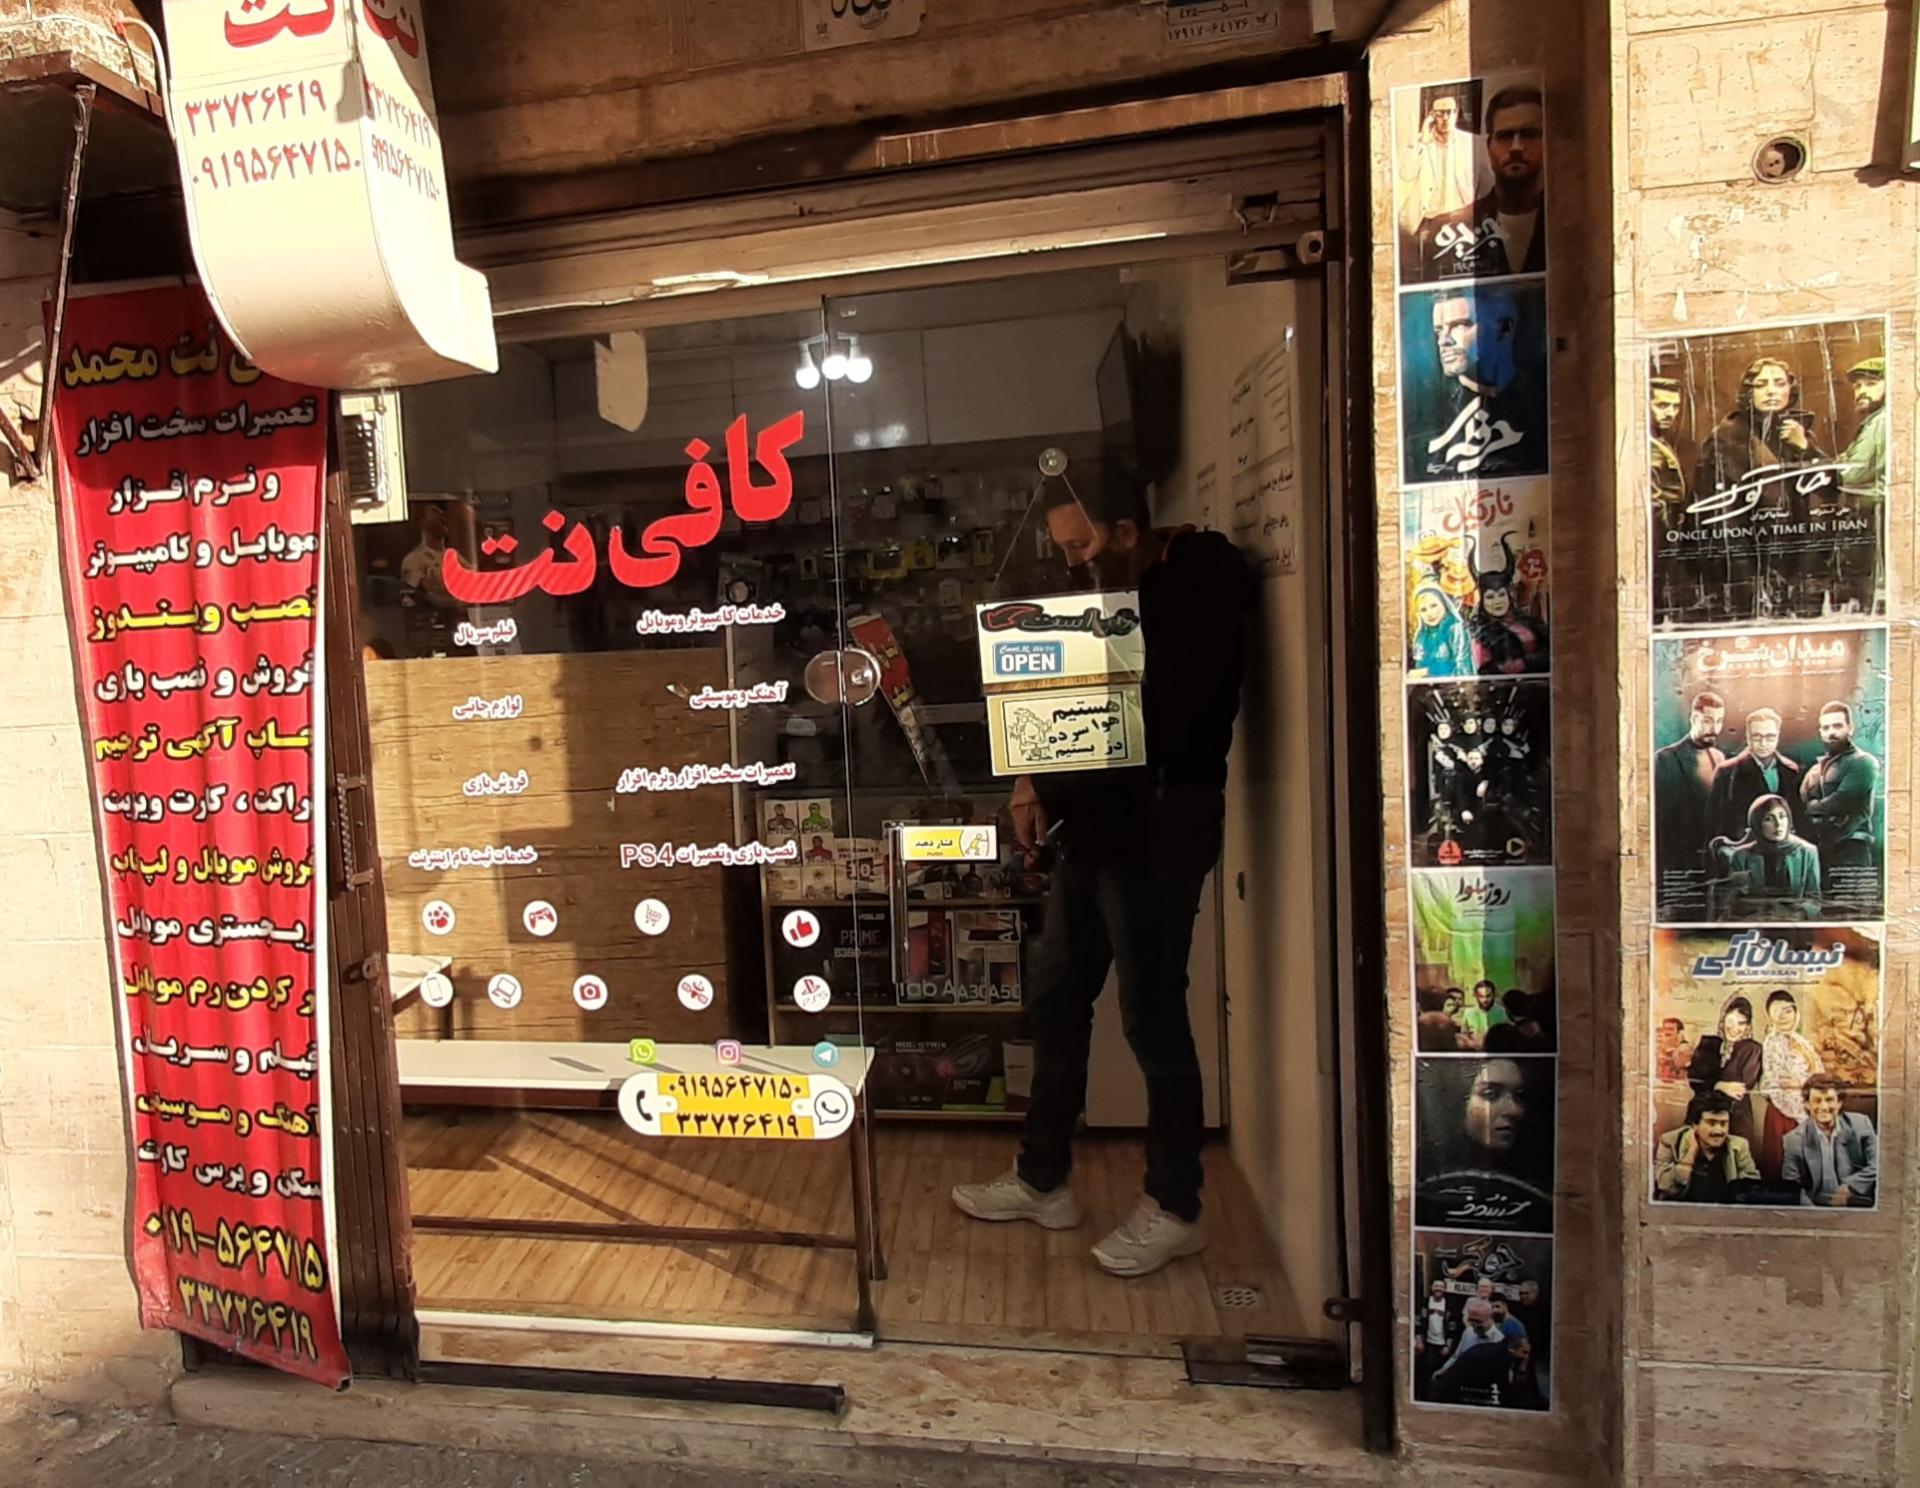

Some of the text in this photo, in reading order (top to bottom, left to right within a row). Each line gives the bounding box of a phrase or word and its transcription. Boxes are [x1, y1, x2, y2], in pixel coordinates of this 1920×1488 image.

[185, 79, 327, 137] ۳۳۷۲۶۴۱۹
[192, 136, 362, 190] ۰۹۱۹۵۶۴۷۱۵۰
[64, 339, 158, 387] محمد
[170, 323, 219, 376] نت
[77, 395, 319, 455] تعمیرات سخت افزار
[108, 464, 280, 515] و نرم افزار
[441, 409, 804, 604] کافی نت
[1666, 519, 1868, 543] ONCE UPON A TIME IN IRAN
[85, 524, 320, 580] موبایل و کامپیوتر
[88, 587, 316, 643] نصب ویندوز
[686, 605, 737, 632] کامپیوتر
[736, 603, 786, 624] خدمات
[455, 619, 517, 645] فیلم سریال
[1001, 652, 1056, 672] OPEN
[1769, 635, 1846, 668] میدان
[95, 654, 314, 702] فروش و نصب بازی
[690, 687, 738, 708] موسیقی
[748, 682, 788, 702] آهنگ
[453, 695, 522, 719] لوازم جانبی
[1052, 700, 1120, 723] هستیم
[165, 716, 240, 760] آگهی
[1091, 716, 1120, 733] هوا
[95, 725, 159, 760] ترحیم
[1055, 743, 1095, 759] بستیم
[463, 769, 529, 796] فروش بازی
[616, 768, 648, 793] افزار
[679, 766, 708, 788] افزار
[708, 764, 744, 784] سخت
[745, 761, 796, 786] تعمیرات
[103, 789, 163, 821] ویزیت
[167, 783, 229, 821] کارت
[409, 845, 538, 871] خدمات ثبت نام اینترنت
[621, 843, 674, 868] PS4
[735, 841, 765, 866] بازی
[766, 839, 797, 863] نصب
[174, 856, 189, 882] و
[193, 848, 257, 884] موبایل
[262, 848, 314, 885] فروش
[1692, 929, 1846, 978] نیسان آبی
[188, 978, 221, 1009] رم
[223, 976, 293, 1009] کردن
[134, 1025, 317, 1078] فیلم و سریال
[668, 1075, 802, 1098] ۰۹۱۹۵۶۴۷۱۵۰
[237, 1112, 251, 1135] و
[676, 1112, 800, 1138] ۳۳۷۲۶۴۱۹
[250, 1171, 269, 1196] و
[178, 1274, 318, 1363] ۳۳۷۲۶۴۱۹
